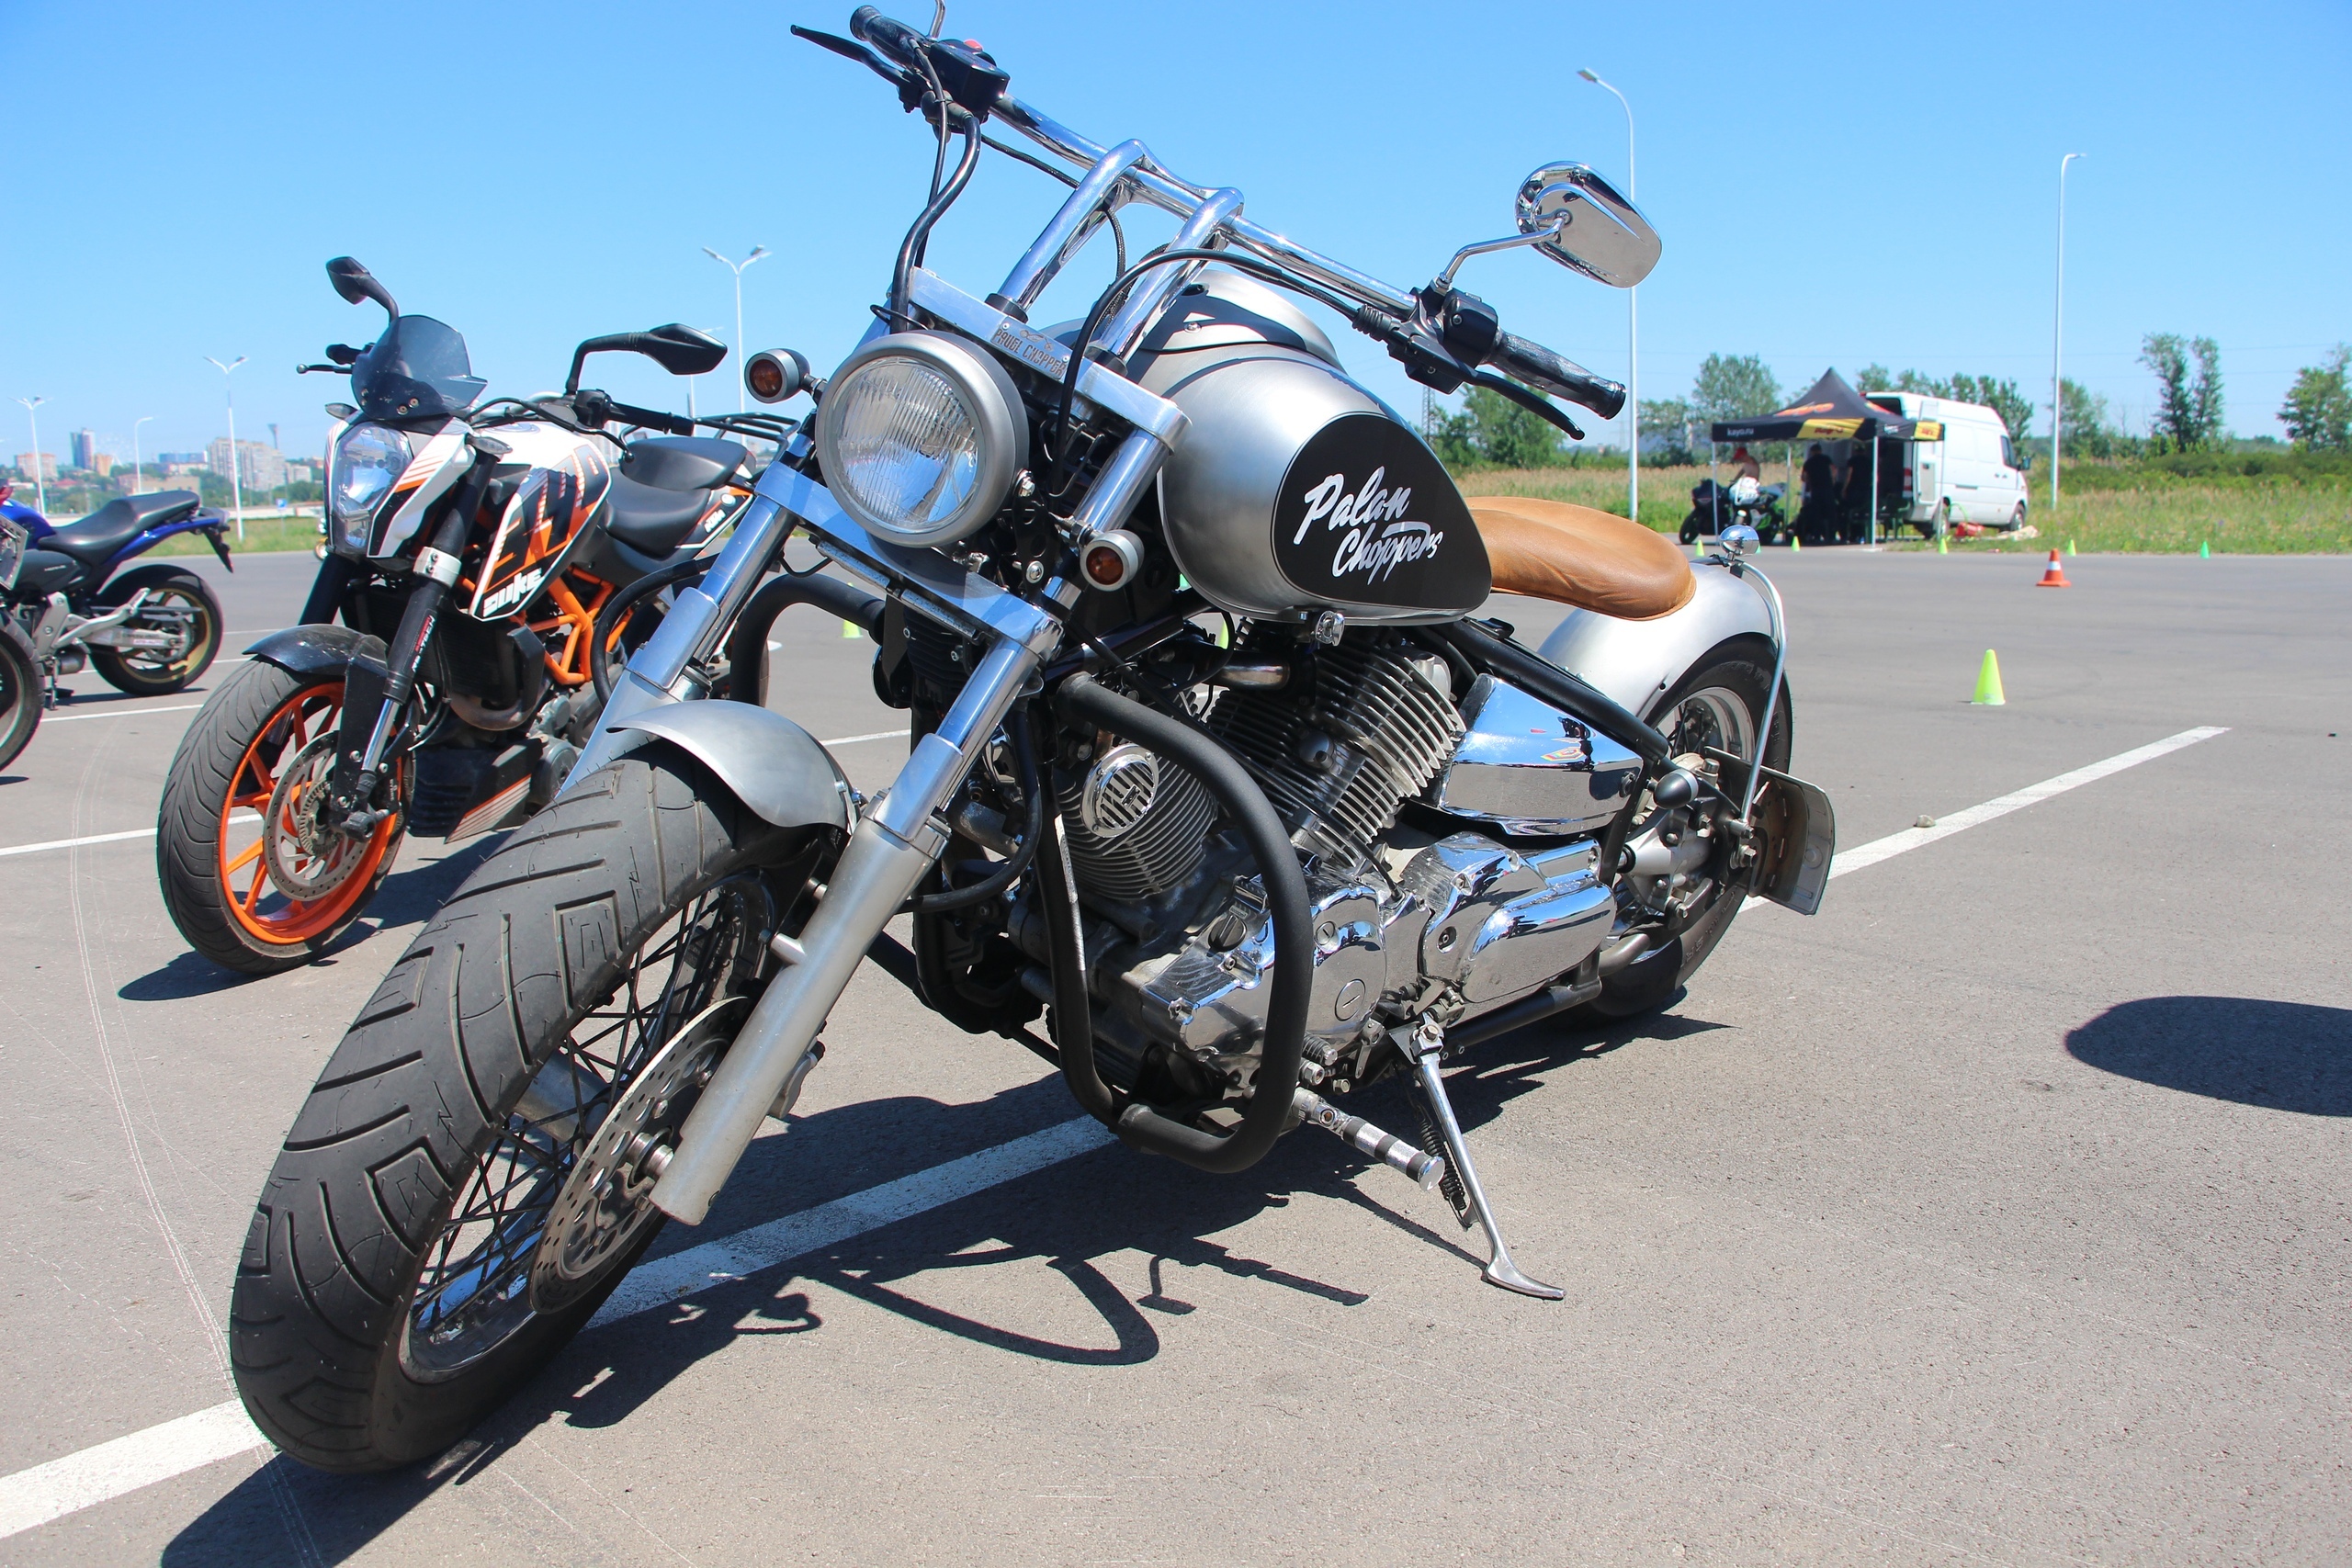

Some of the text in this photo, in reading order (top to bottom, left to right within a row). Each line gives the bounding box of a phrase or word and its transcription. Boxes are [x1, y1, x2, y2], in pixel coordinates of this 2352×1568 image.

[1022, 344, 1067, 378] CHOPPER
[1727, 427, 1755, 437] kayo.ru
[1332, 521, 1443, 585] Choppers
